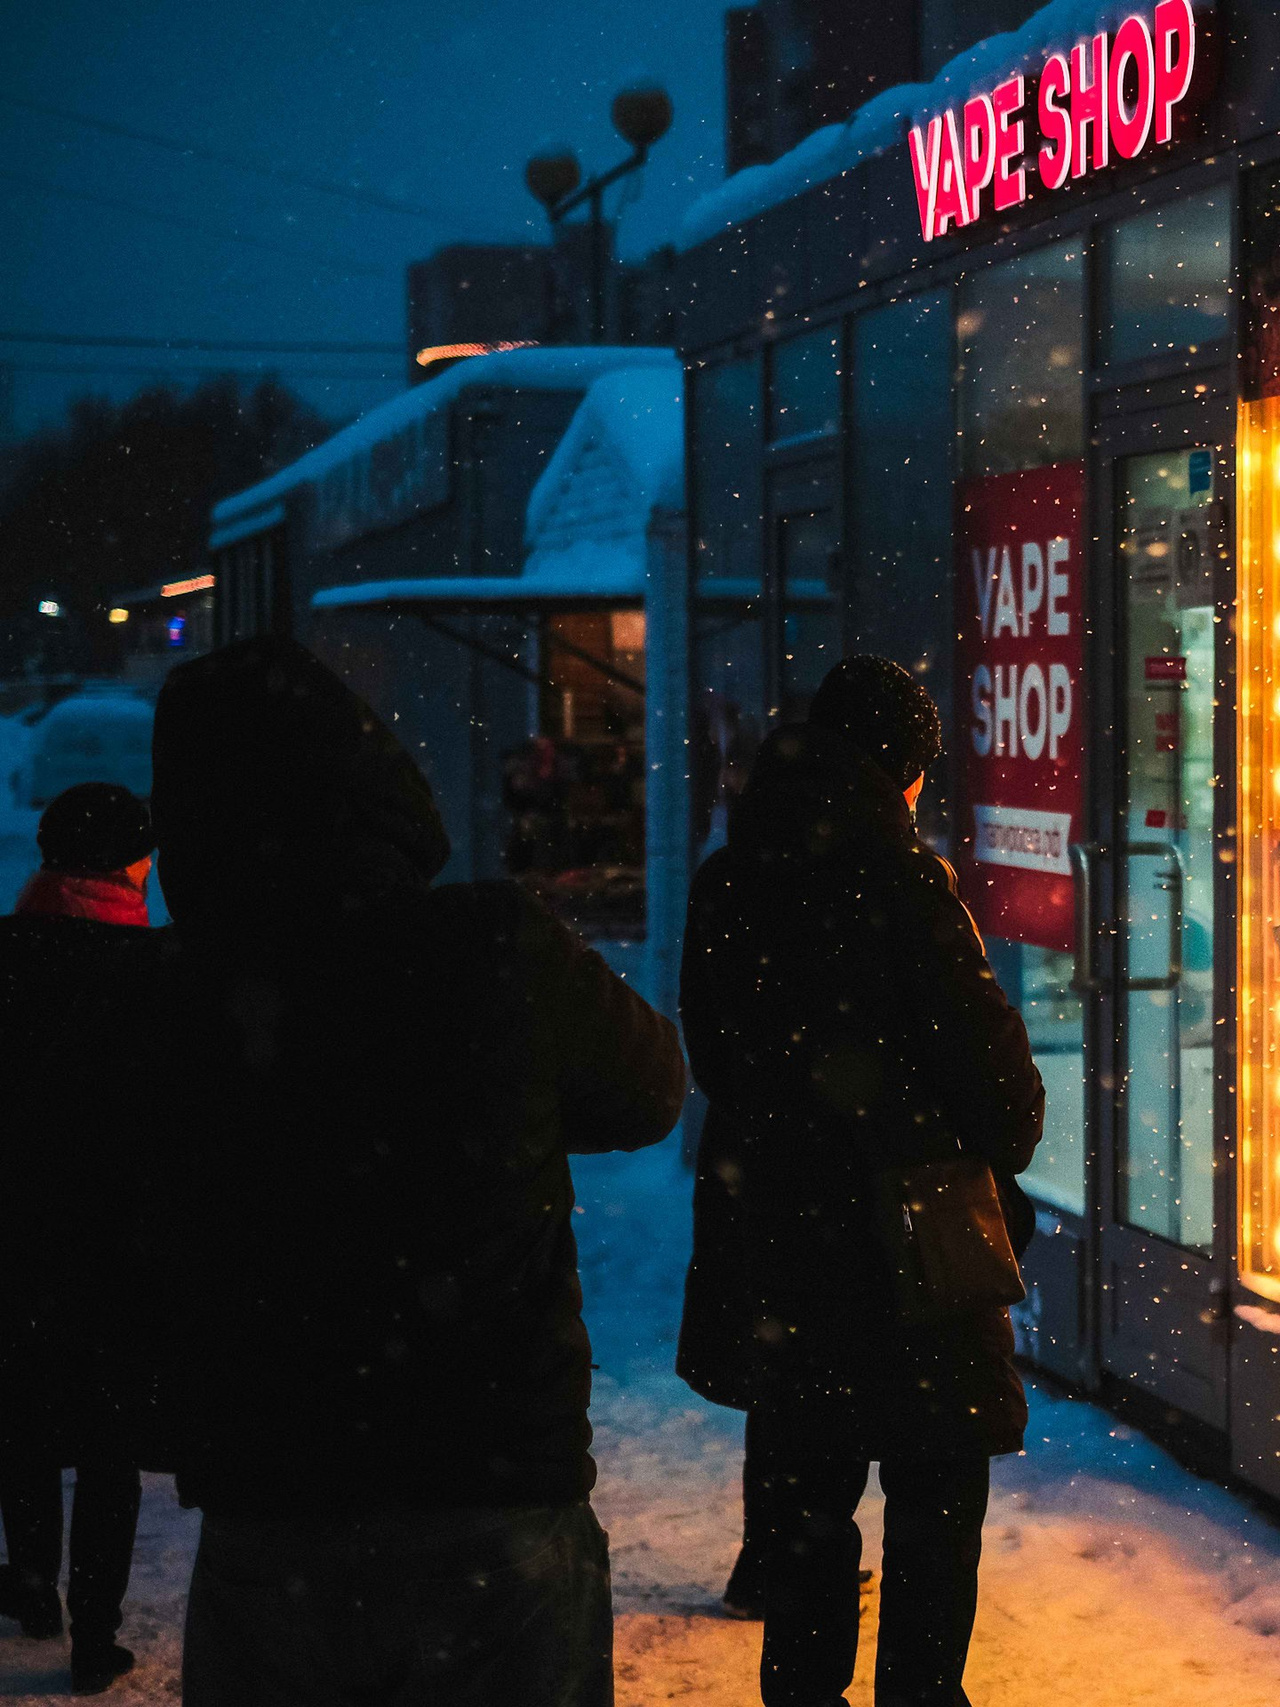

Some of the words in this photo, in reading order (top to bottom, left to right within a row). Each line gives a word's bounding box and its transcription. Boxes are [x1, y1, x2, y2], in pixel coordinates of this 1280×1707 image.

[908, 75, 1026, 242] VAPE
[1038, 0, 1195, 190] SHOP
[972, 538, 1069, 638] VAPE
[971, 663, 1072, 760] SHOP
